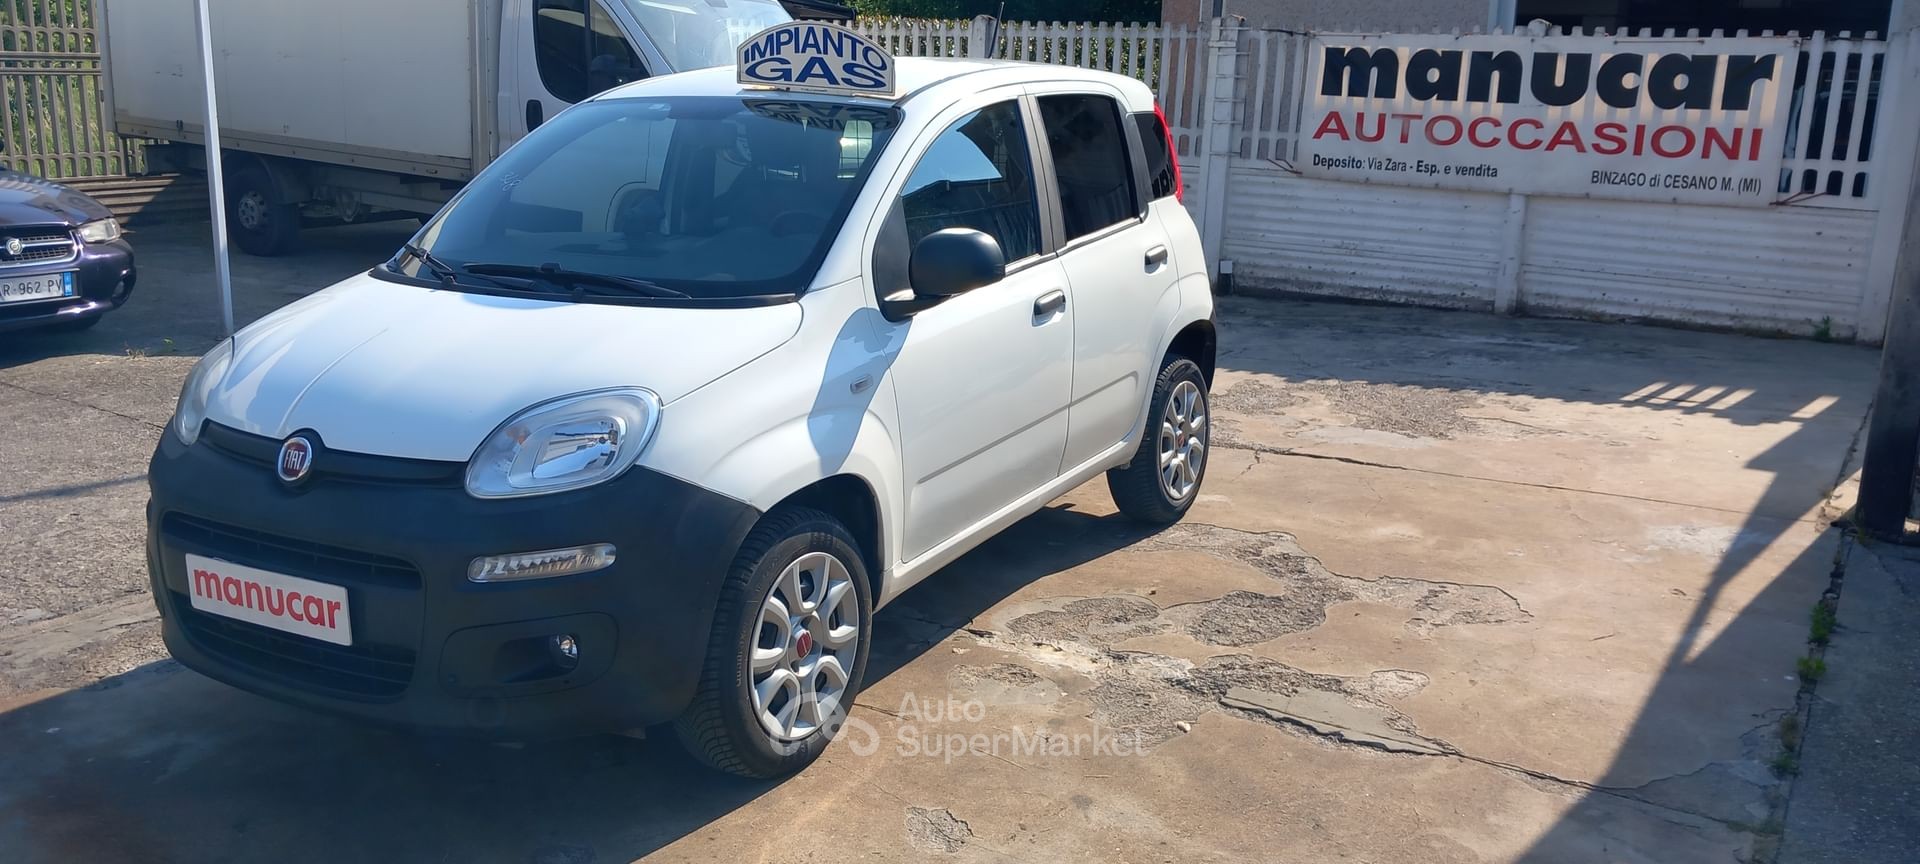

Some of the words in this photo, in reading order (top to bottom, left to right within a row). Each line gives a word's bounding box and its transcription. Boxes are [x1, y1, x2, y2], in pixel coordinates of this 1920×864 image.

[744, 26, 888, 71] IMPIANTO
[745, 56, 887, 89] GAS
[1320, 46, 1776, 111] manucar
[1312, 110, 1764, 161] AUTOCCASIONI
[1313, 153, 1366, 170] Deposito:
[1367, 157, 1383, 170] Via
[1384, 158, 1408, 172] Zara
[1416, 160, 1440, 176] Esp.
[1443, 165, 1451, 174] e
[1455, 163, 1498, 178] vendita
[1591, 170, 1646, 187] BINZAGO
[1649, 173, 1661, 188] di
[1663, 174, 1718, 190] CESANO
[1720, 177, 1735, 192] M.
[1737, 178, 1761, 196] (MI)
[18, 281, 41, 295] 962
[47, 279, 62, 293] PV
[284, 449, 304, 471] FIAT
[193, 569, 341, 629] manucar
